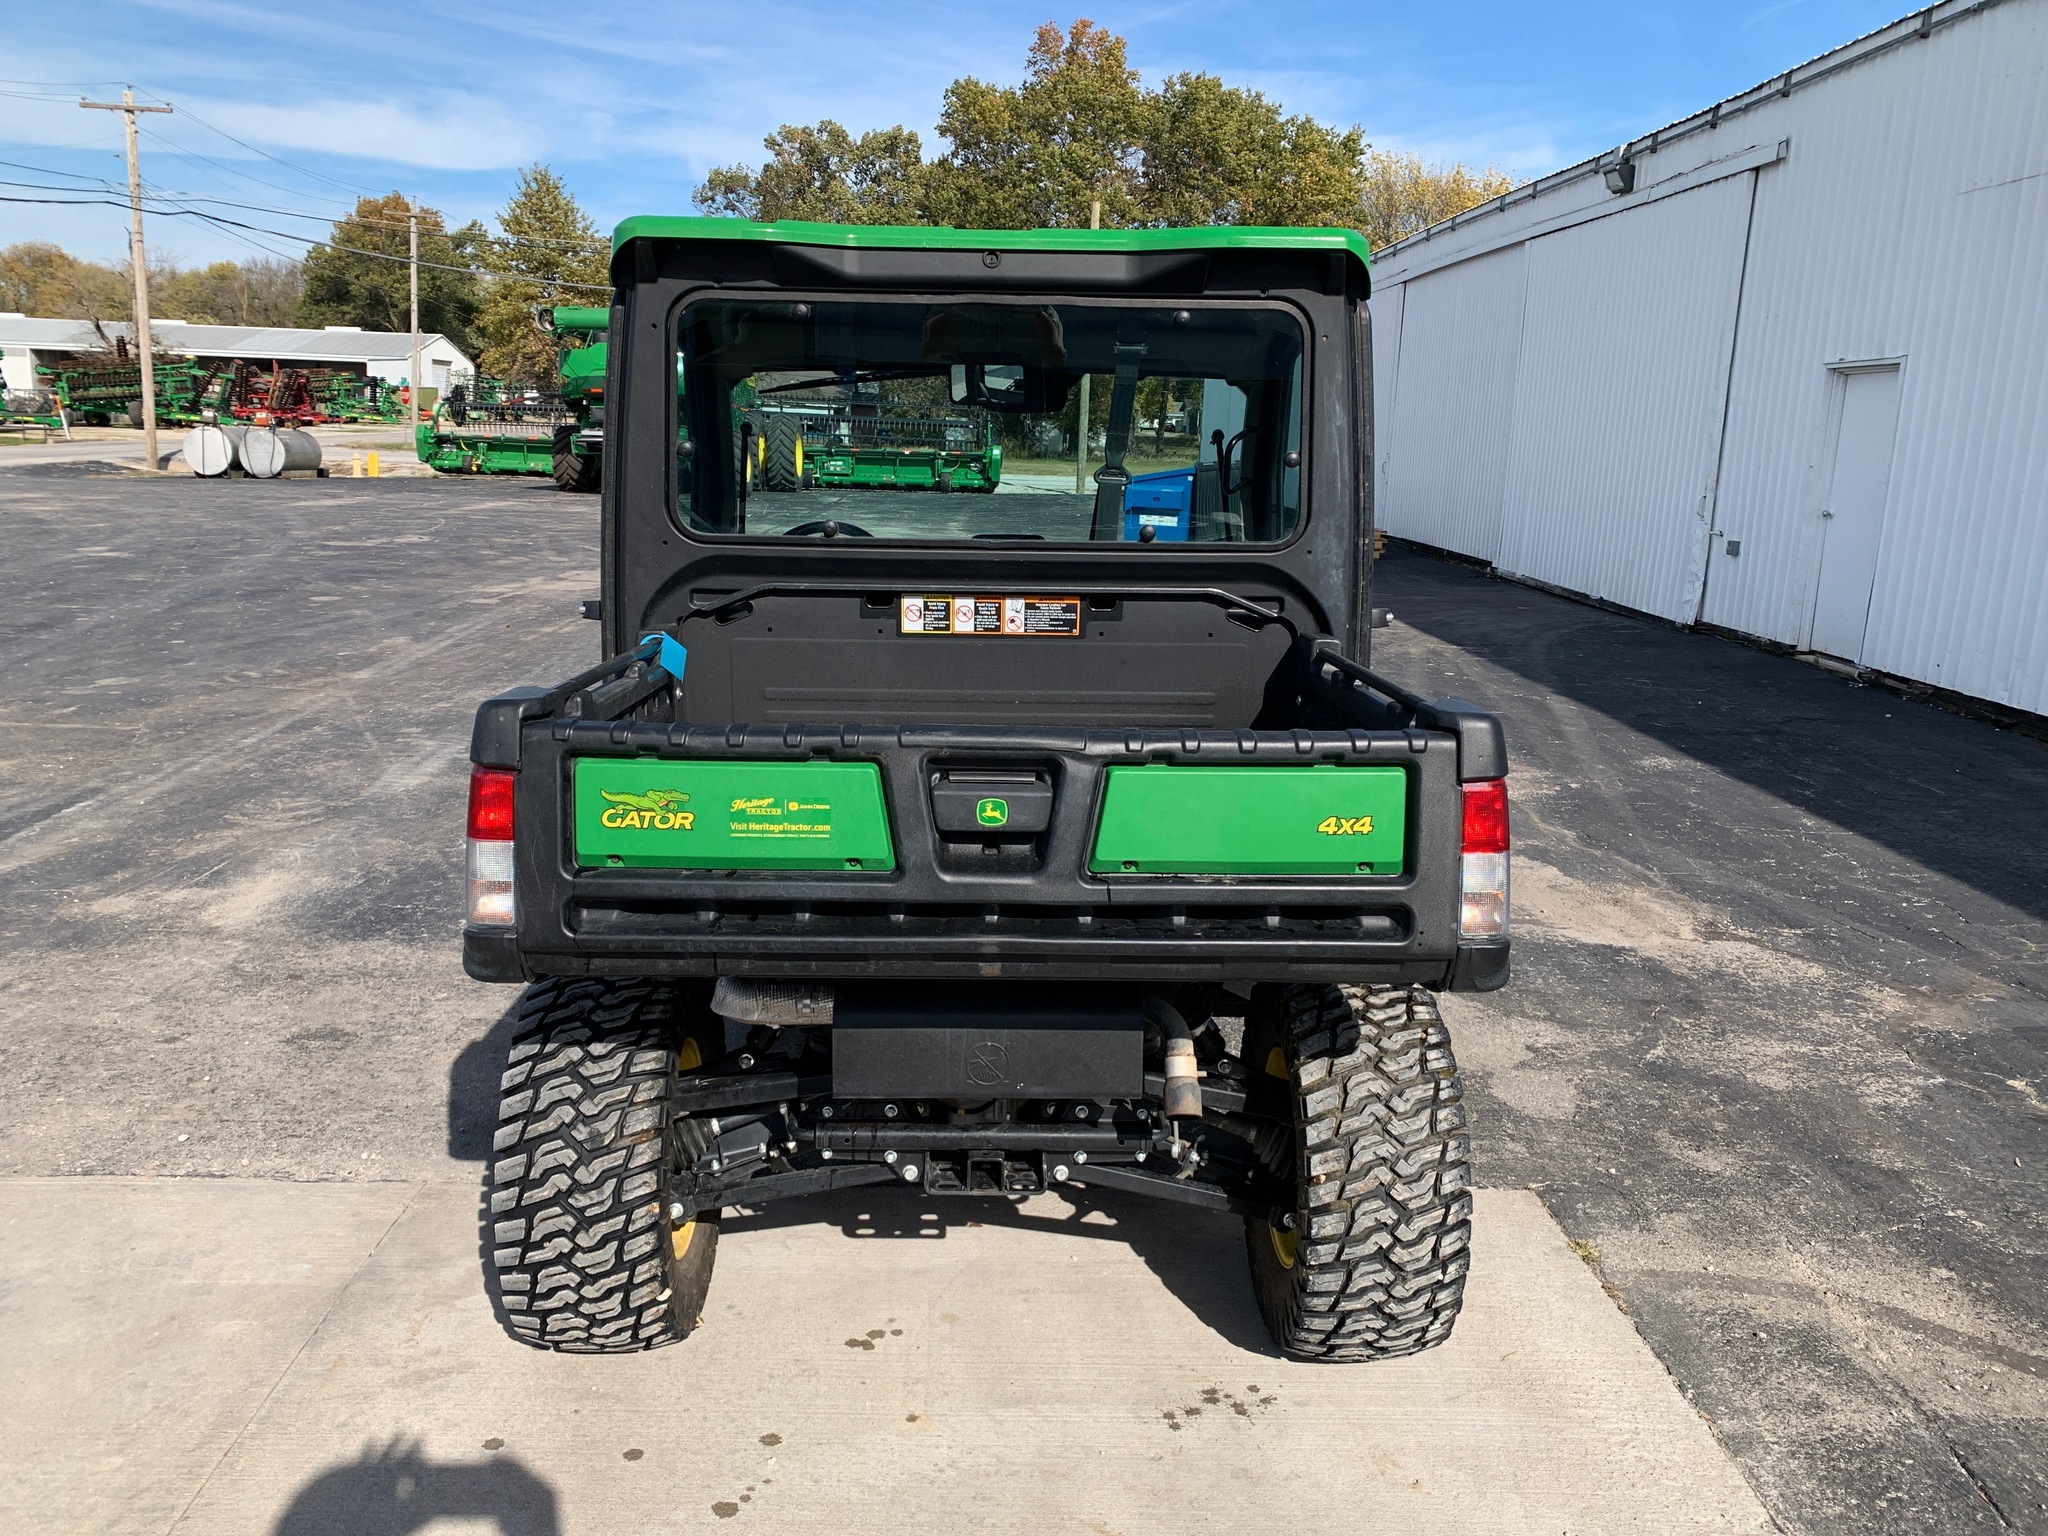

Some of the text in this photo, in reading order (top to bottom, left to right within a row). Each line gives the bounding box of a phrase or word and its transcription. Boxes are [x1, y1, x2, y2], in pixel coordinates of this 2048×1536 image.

[730, 798, 775, 812] Heritage
[601, 808, 695, 831] GATOR
[729, 822, 831, 833] Visit HeritageTractor.com
[1317, 815, 1375, 836] 4x4
